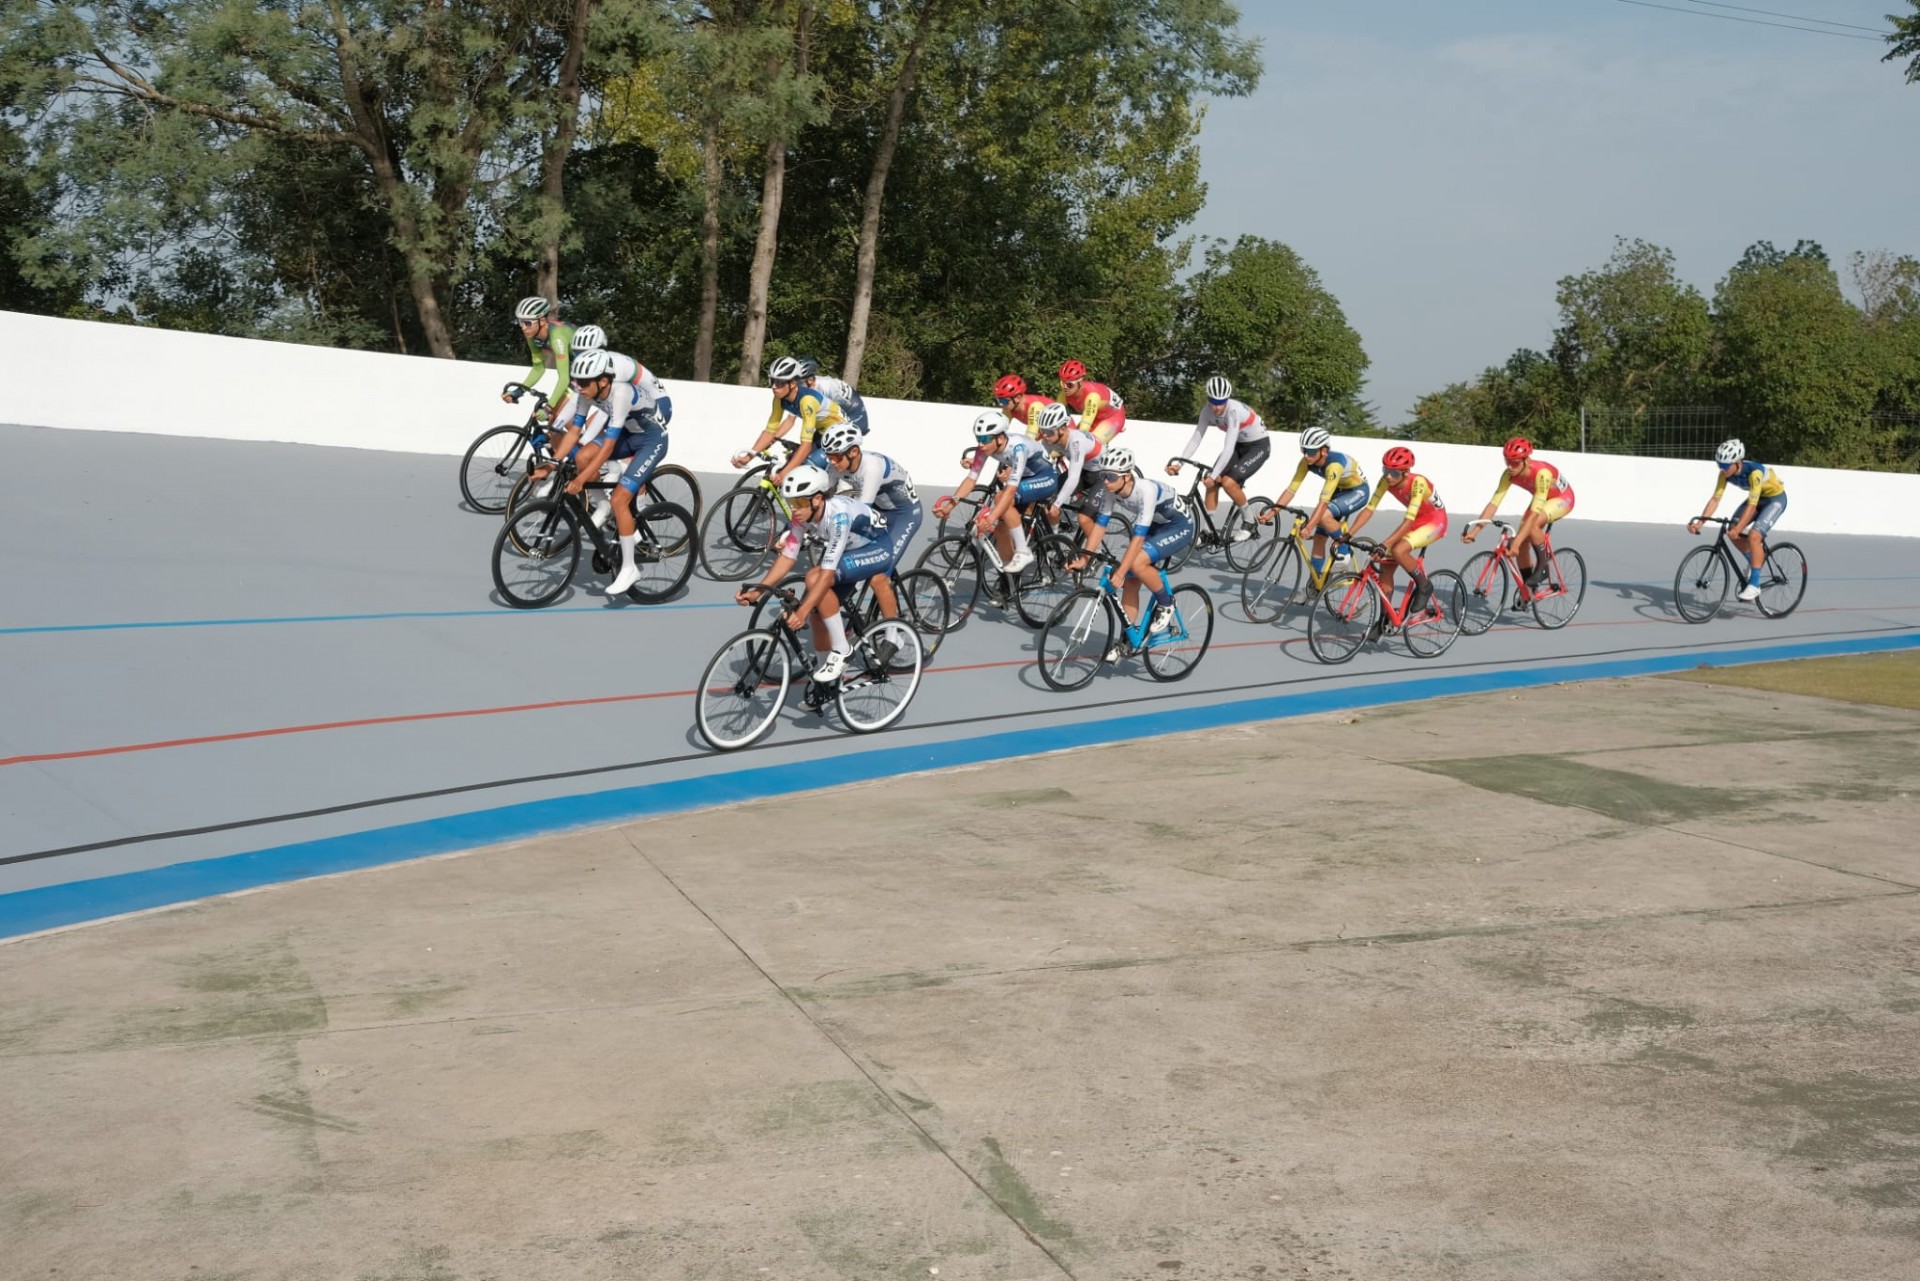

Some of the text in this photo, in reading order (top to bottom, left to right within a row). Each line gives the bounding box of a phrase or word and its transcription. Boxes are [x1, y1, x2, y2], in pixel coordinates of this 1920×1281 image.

[633, 443, 663, 478] VESAM
[1156, 528, 1191, 548] VESAM
[854, 551, 890, 568] PAREDES
